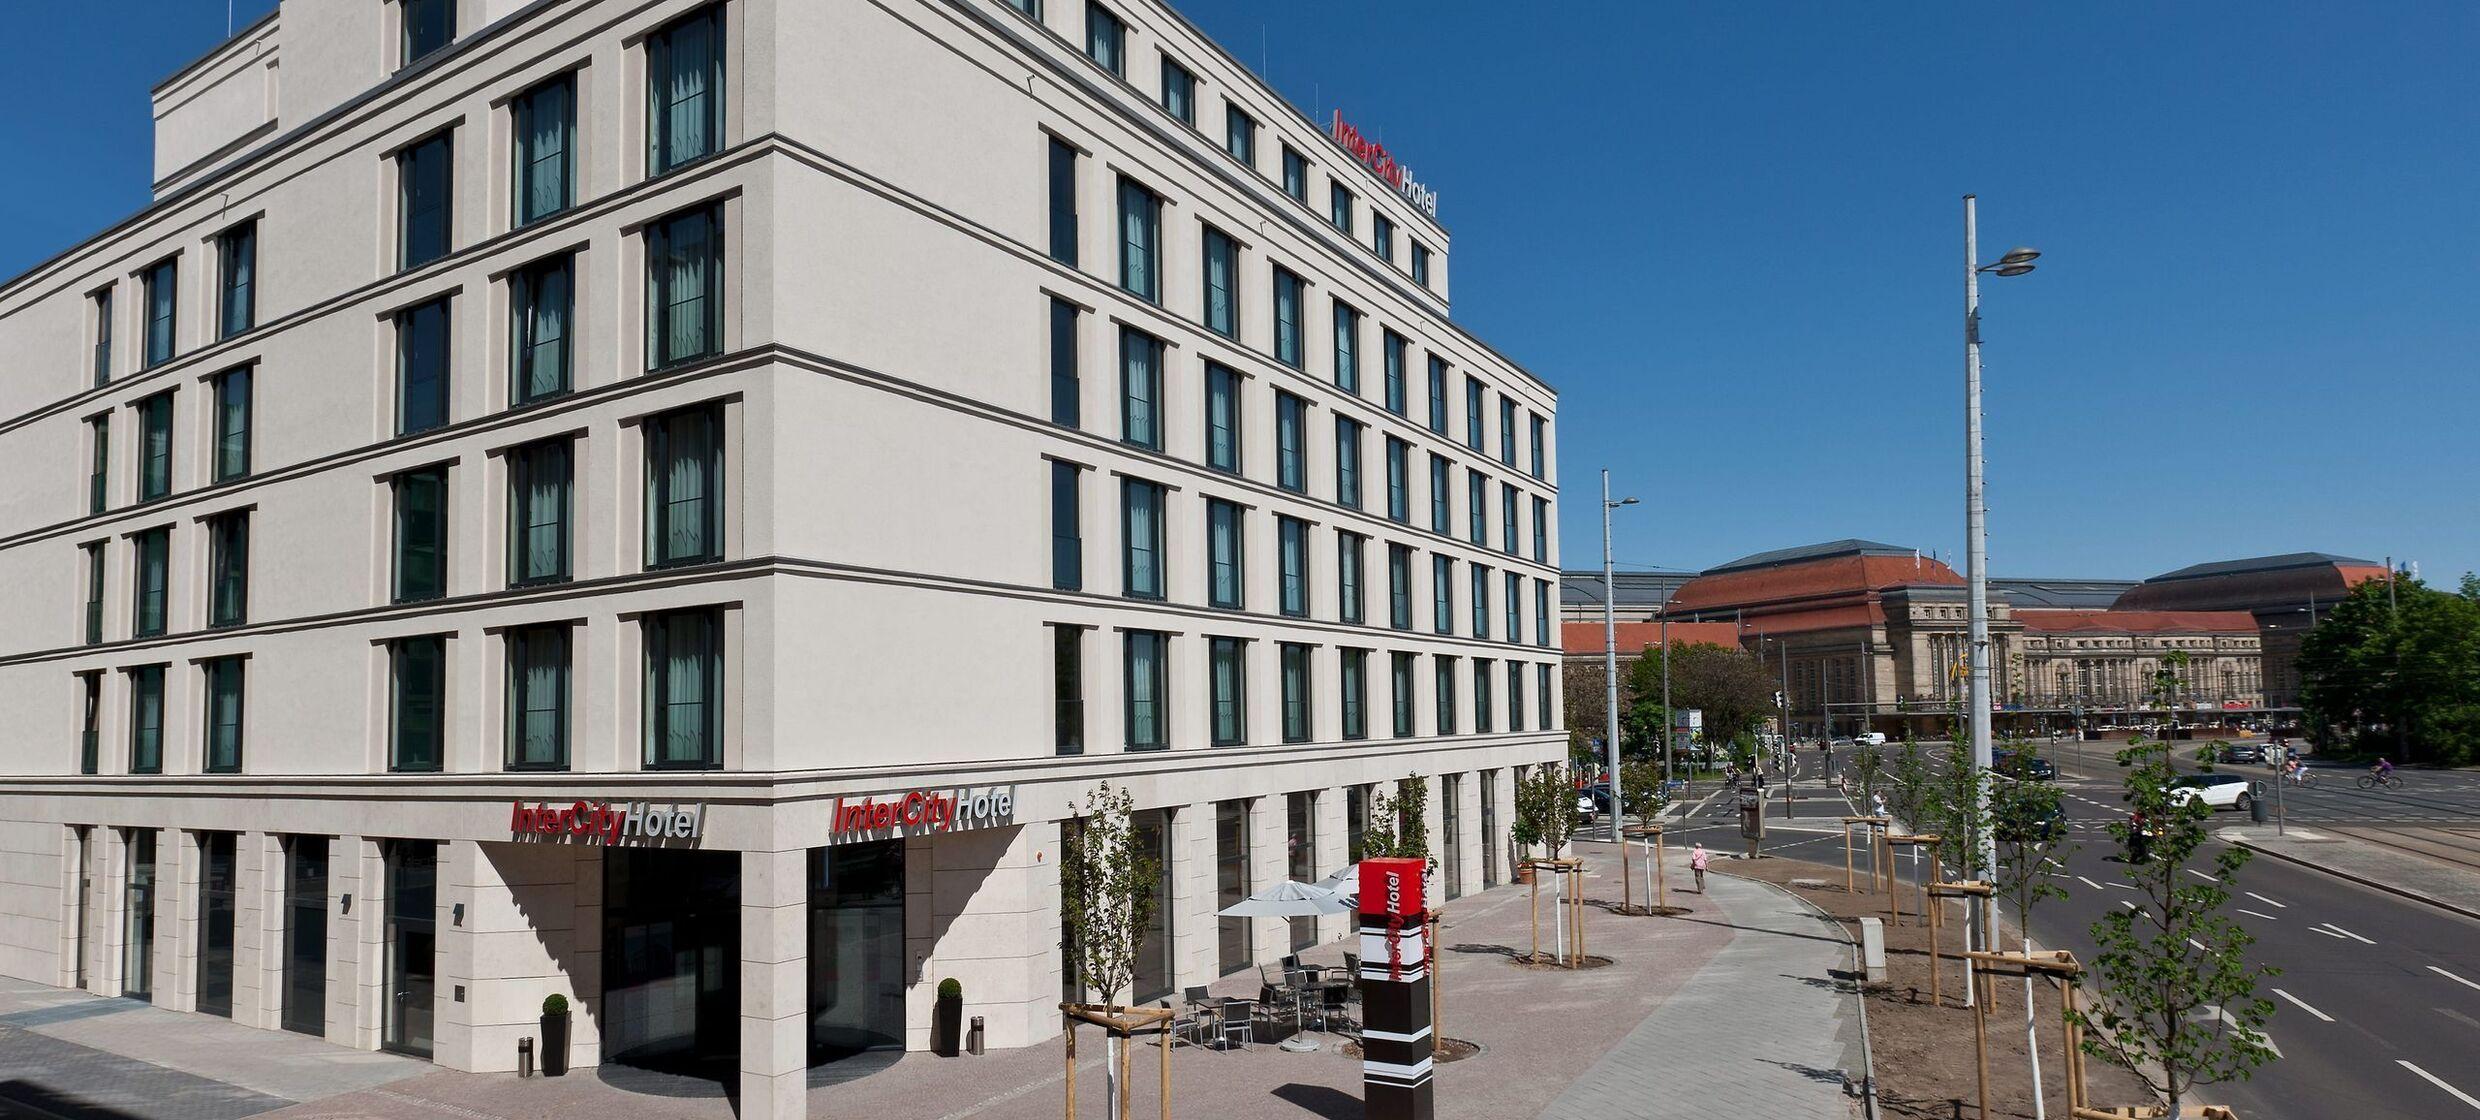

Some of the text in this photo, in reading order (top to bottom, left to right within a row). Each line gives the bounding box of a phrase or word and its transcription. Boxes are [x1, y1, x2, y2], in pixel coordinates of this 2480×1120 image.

[1333, 108, 1437, 218] InterCityHotel
[511, 800, 703, 847] InterCityHotel
[834, 786, 1016, 832] InterCityHotel
